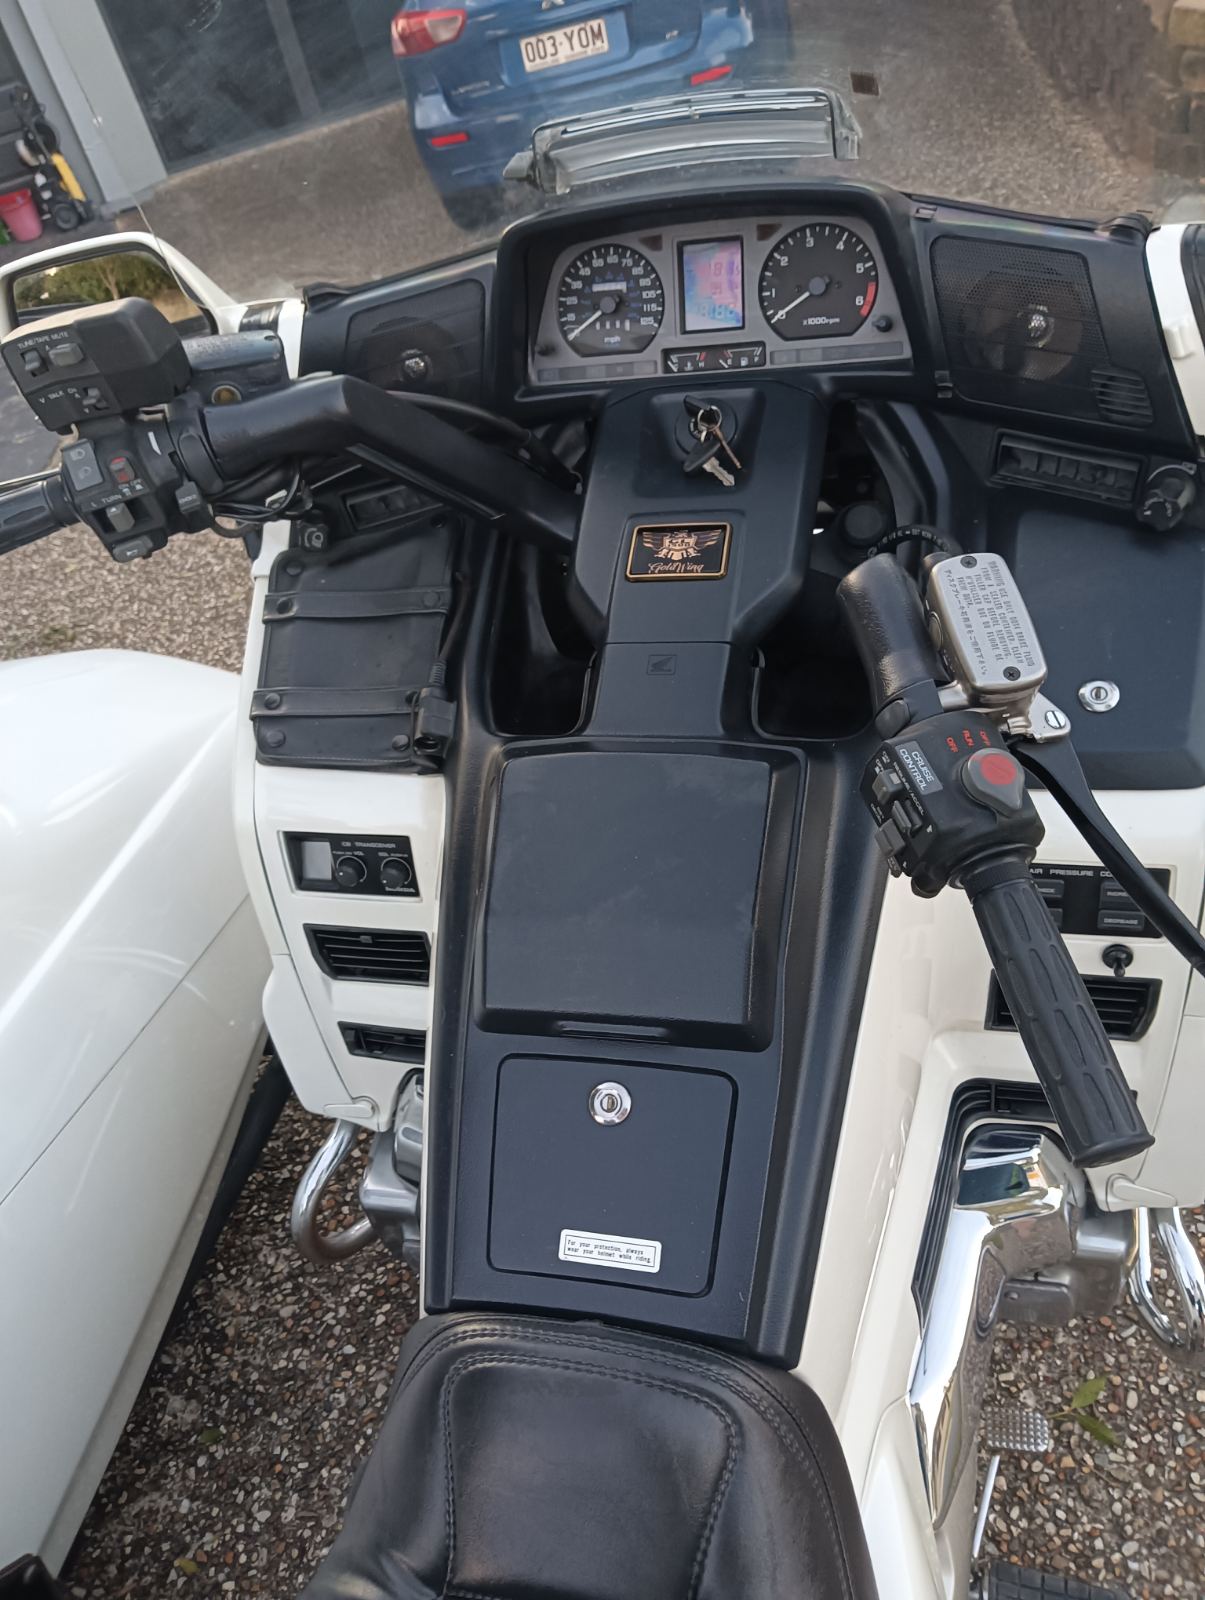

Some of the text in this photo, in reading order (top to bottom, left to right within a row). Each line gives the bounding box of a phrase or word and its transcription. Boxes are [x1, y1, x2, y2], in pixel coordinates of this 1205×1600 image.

[806, 237, 814, 247] 3
[836, 241, 845, 250] 4
[780, 256, 789, 266] 2
[856, 263, 864, 273] 5
[855, 296, 864, 305] 6
[899, 748, 929, 792] CONTROL
[911, 751, 935, 783] CRUISE
[1050, 869, 1094, 877] PRESSURE
